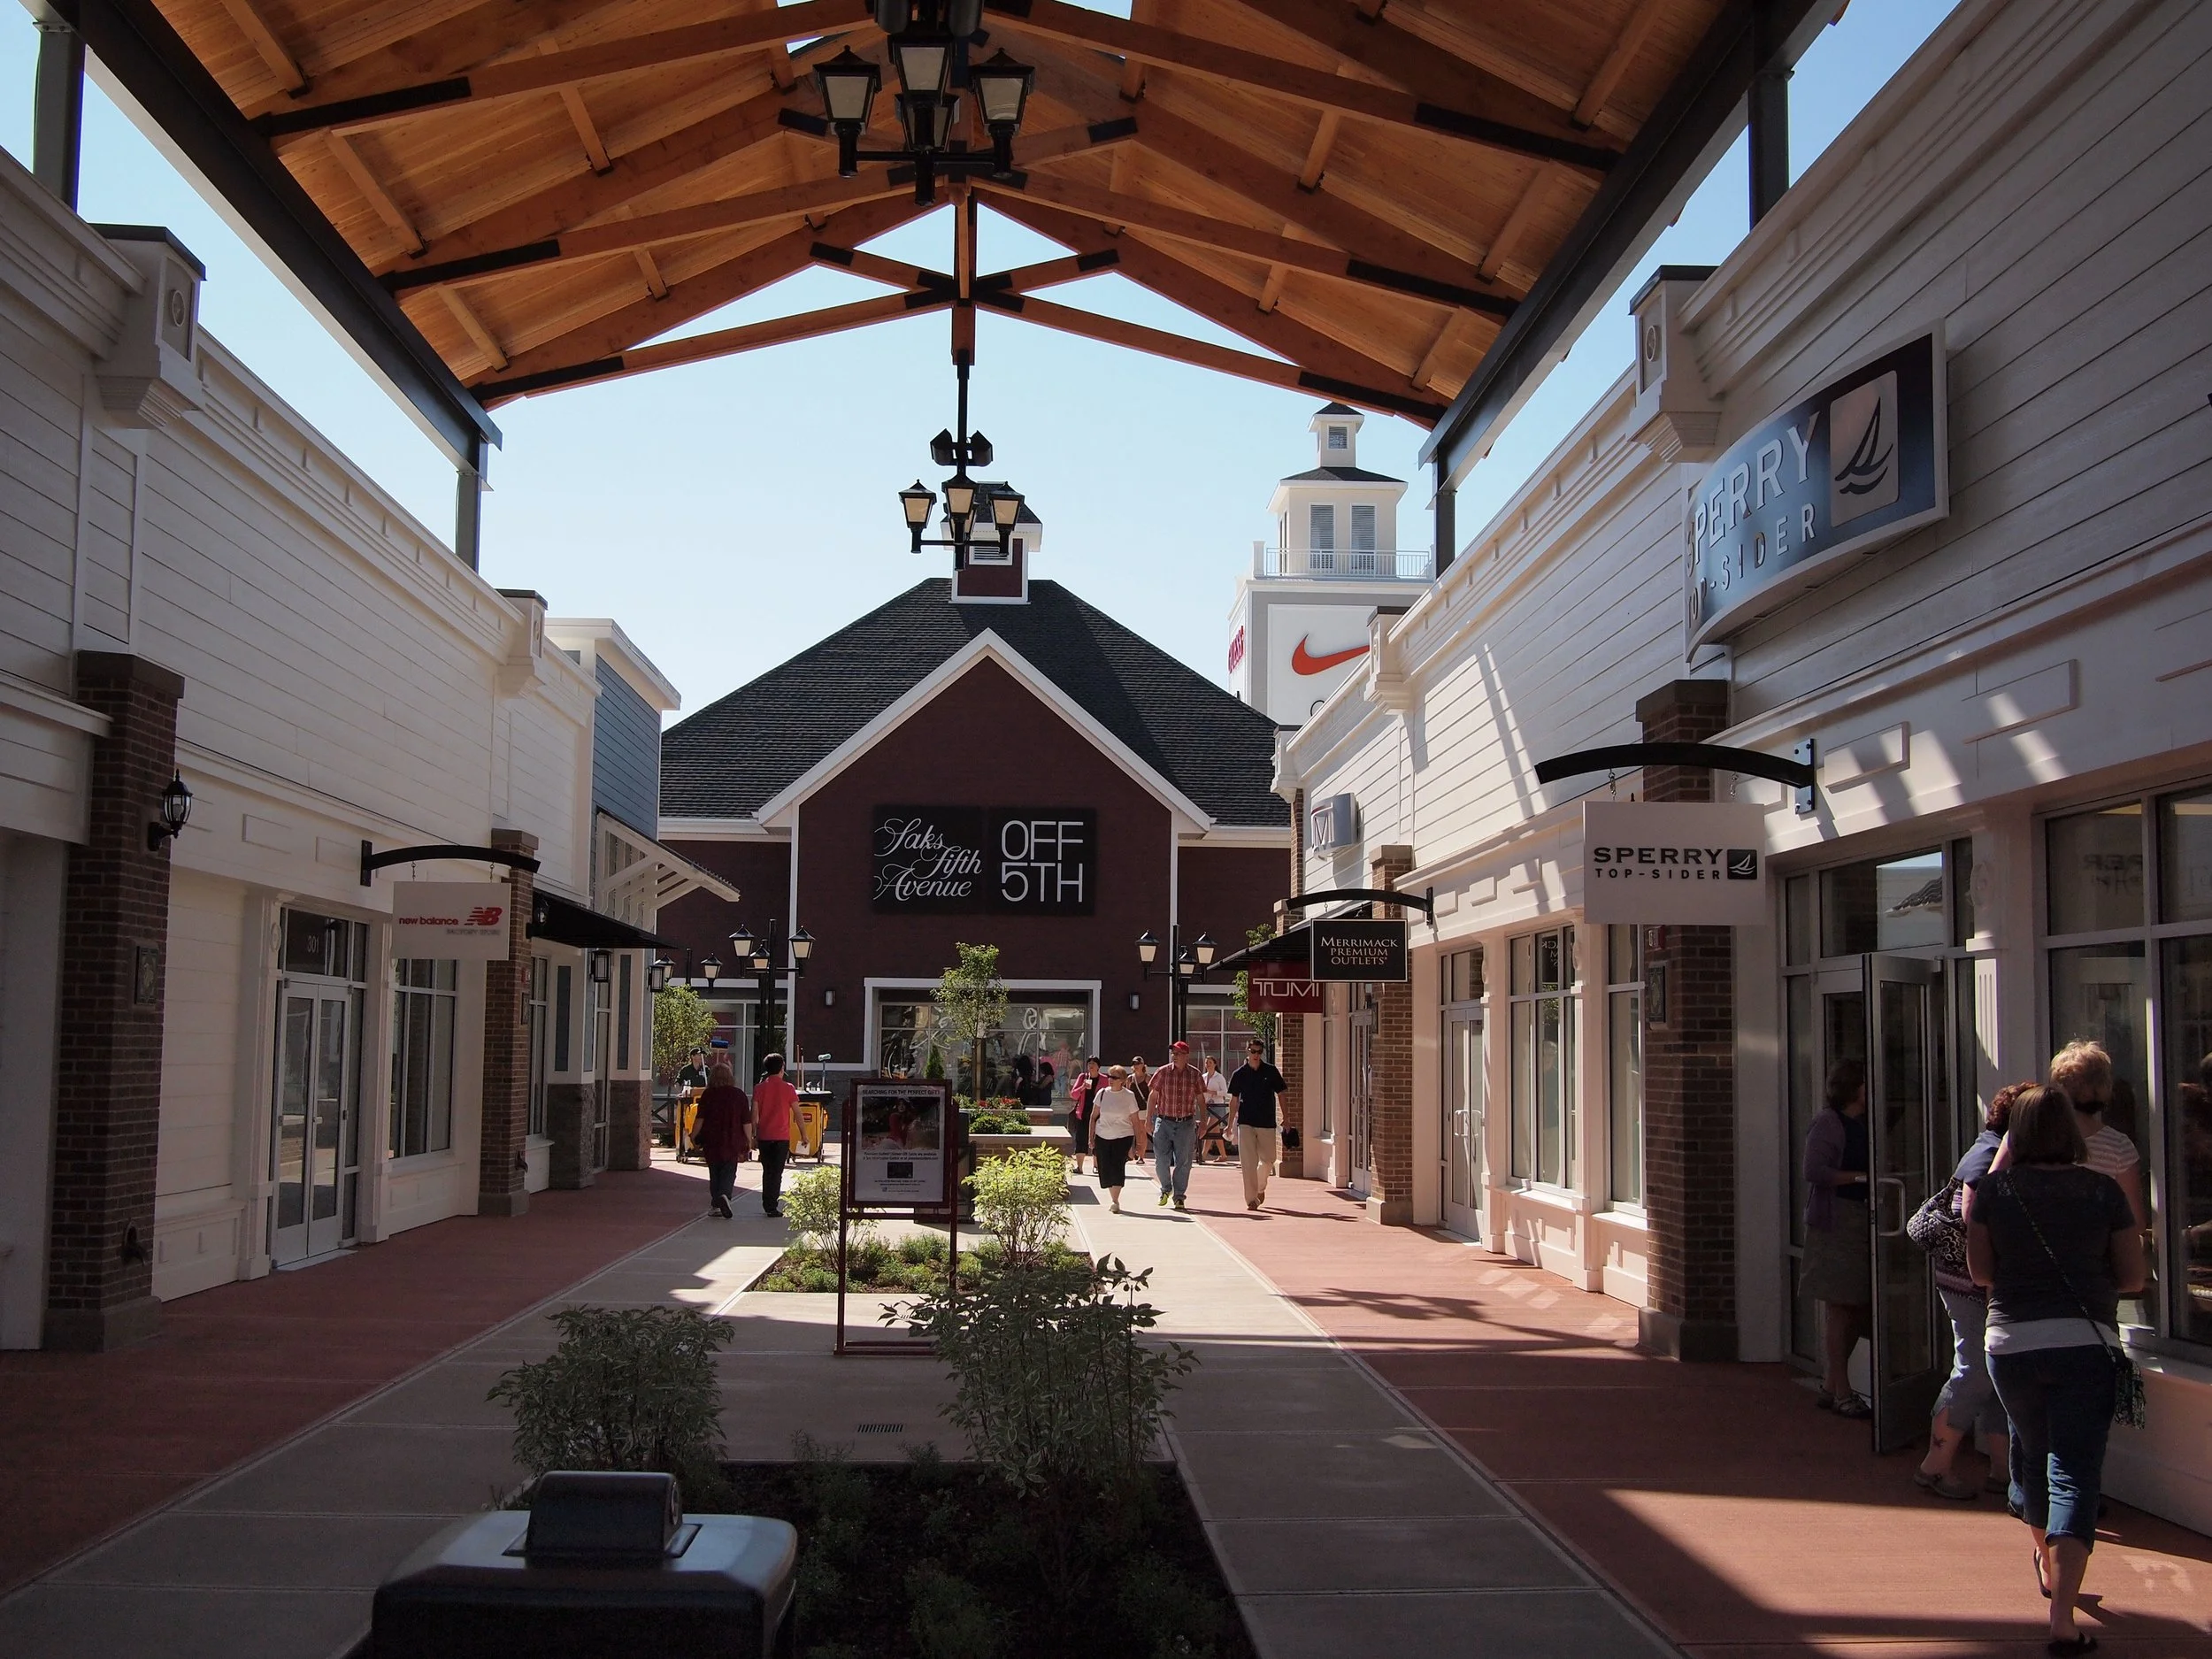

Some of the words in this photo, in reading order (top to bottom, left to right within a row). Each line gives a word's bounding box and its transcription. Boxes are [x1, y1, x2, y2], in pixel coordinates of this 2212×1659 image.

[874, 818, 944, 861] Saks
[1001, 819, 1084, 861] OFF
[1593, 847, 1724, 864] SPERRY
[873, 863, 972, 902] Avenue
[1001, 861, 1084, 902] 5TH
[1594, 868, 1720, 879] TOP-SIDER
[398, 917, 418, 926] new
[419, 916, 459, 926] balance
[307, 934, 319, 954] 301
[1320, 936, 1399, 948] MERRIMACK
[1252, 978, 1319, 997] TUMI
